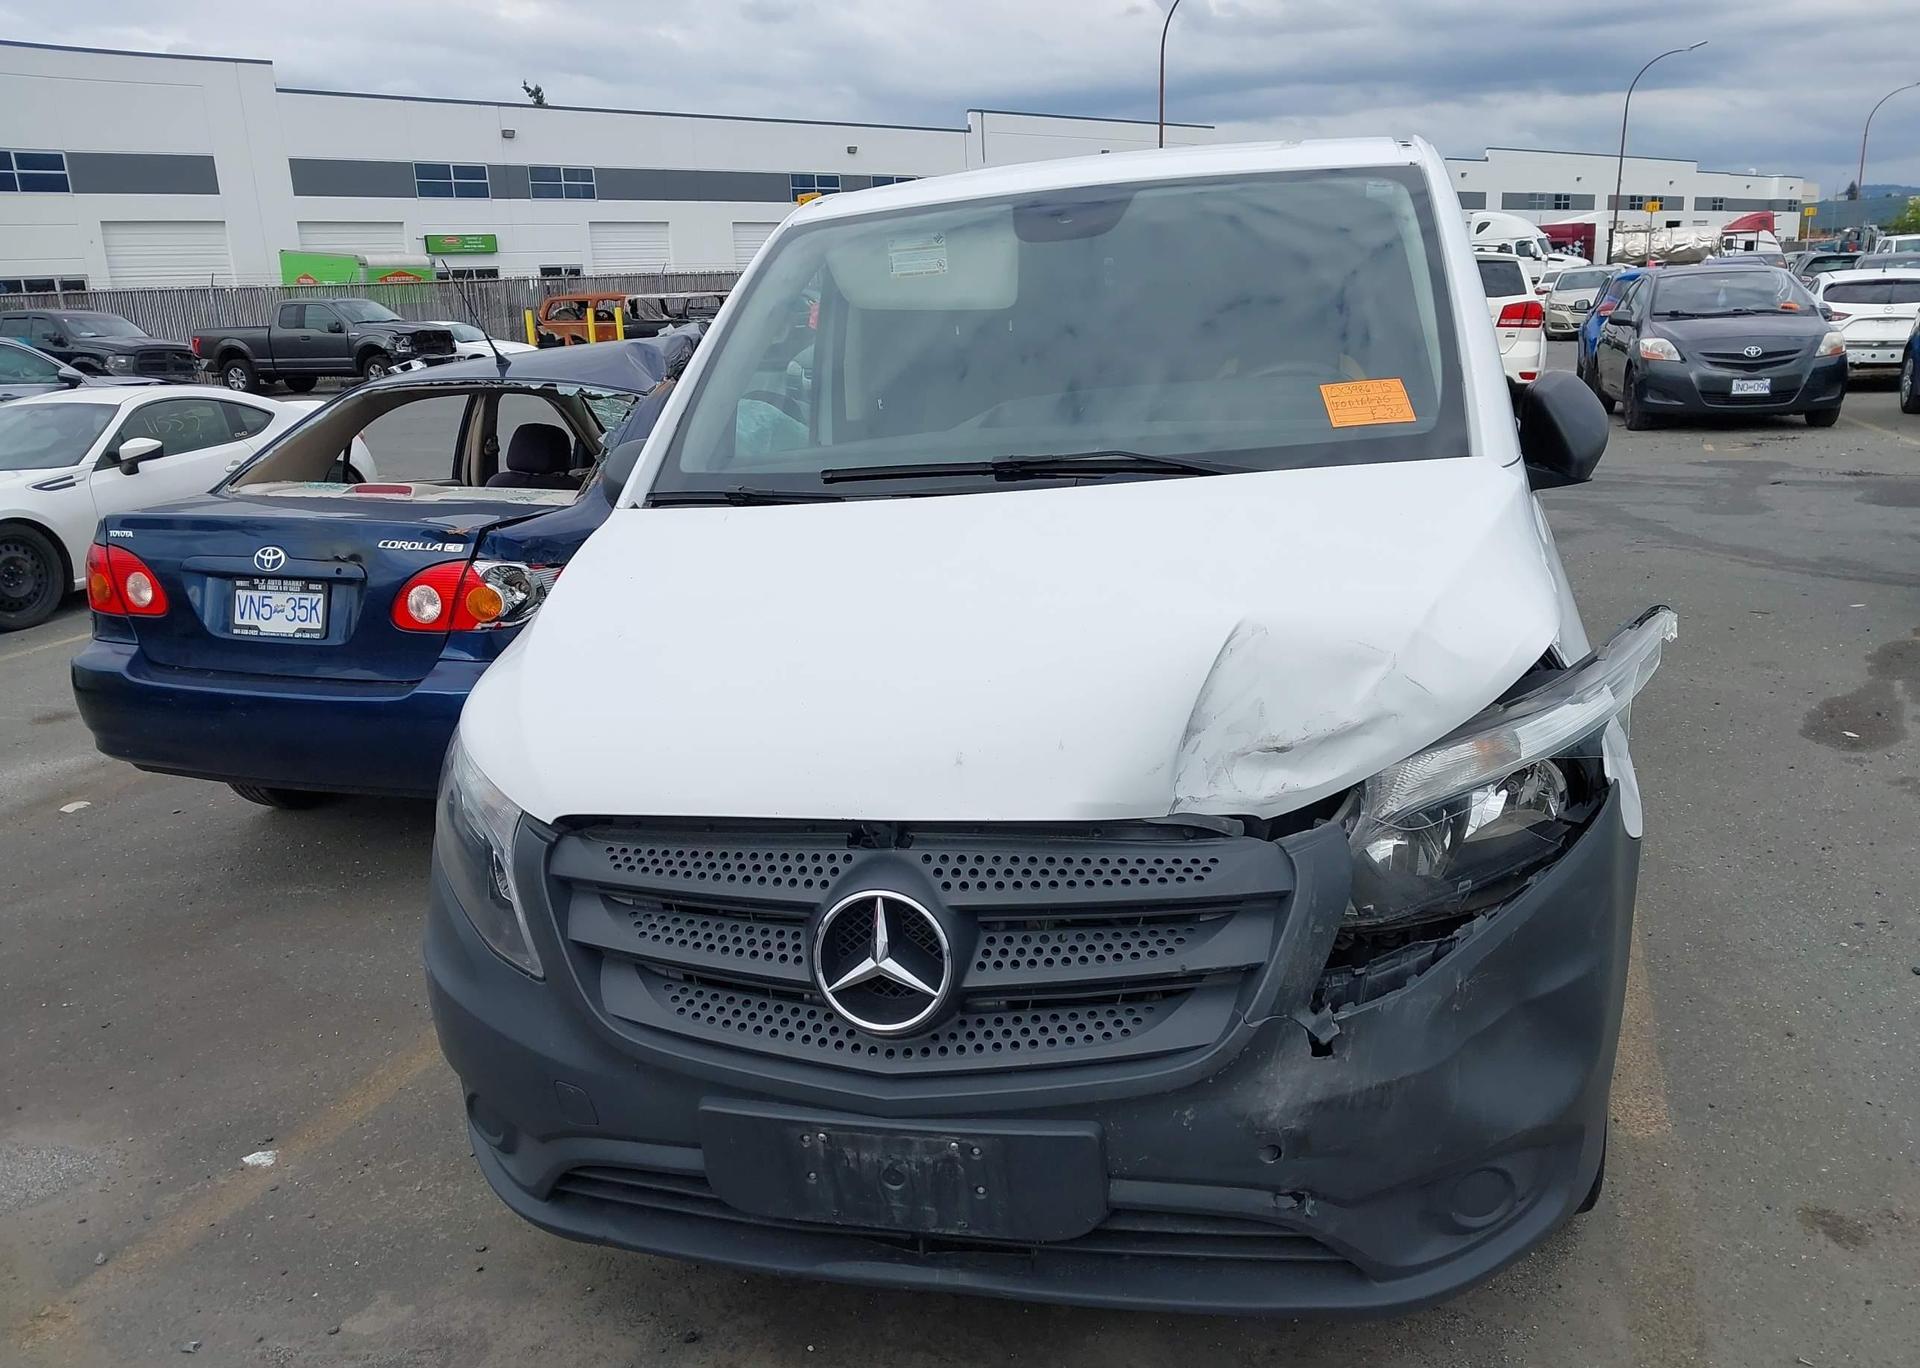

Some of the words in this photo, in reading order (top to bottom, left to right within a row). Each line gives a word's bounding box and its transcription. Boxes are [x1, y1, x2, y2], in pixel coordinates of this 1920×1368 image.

[109, 530, 134, 538] TOYOTA
[378, 539, 444, 551] COROLLA
[237, 594, 273, 621] VN5
[285, 596, 321, 624] 35K
